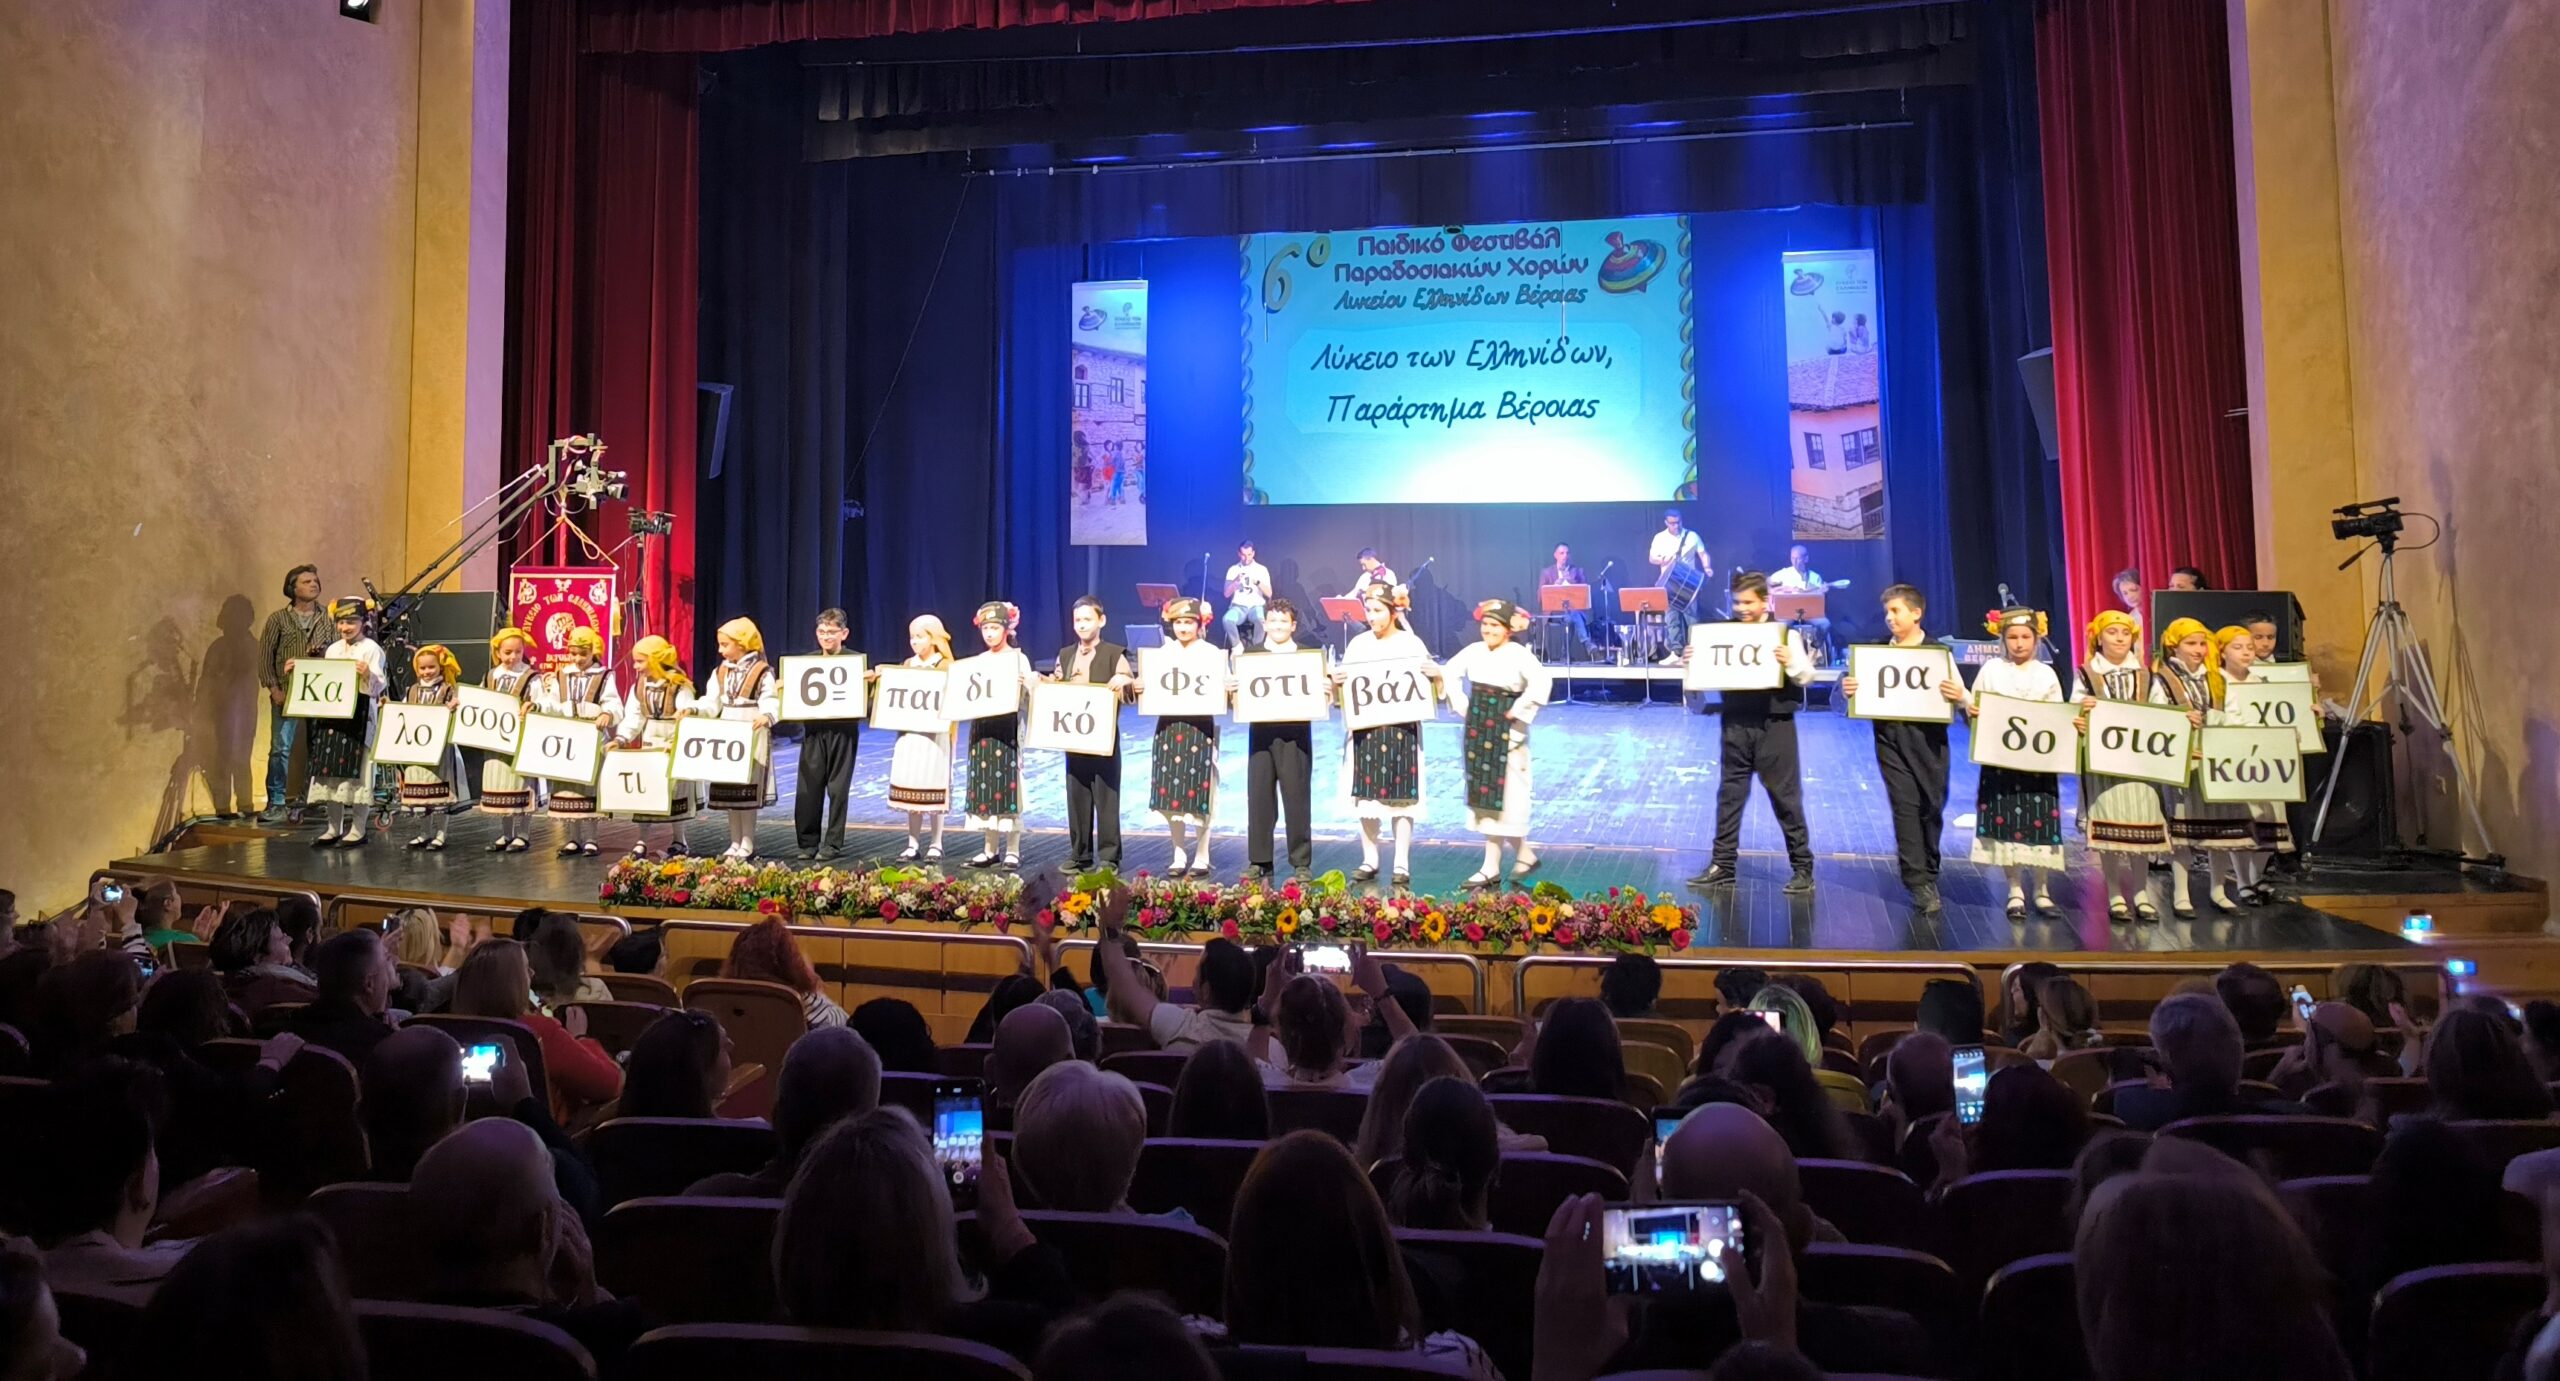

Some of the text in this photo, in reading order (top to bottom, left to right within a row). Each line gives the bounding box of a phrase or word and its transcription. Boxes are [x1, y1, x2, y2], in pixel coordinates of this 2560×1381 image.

[1358, 226, 1561, 256] Παιδικό Φεστιβάλ
[1334, 253, 1589, 286] Παραδοσιακών Χορών
[1333, 289, 1407, 311] Λυκείου
[1310, 335, 1613, 371] Λύκειο των Ελληνίδων,
[1327, 390, 1600, 429] Παράρτημα Βέροιας
[1709, 643, 1762, 668] πα
[300, 672, 343, 703] Κα
[966, 672, 995, 702] δι
[1160, 667, 1210, 696] Φε
[1250, 674, 1312, 698] στι
[1351, 670, 1427, 716] βάλ
[1877, 664, 1932, 699] ρα
[887, 687, 941, 712] παι
[2250, 700, 2296, 727] χο
[394, 711, 433, 747] λο
[460, 704, 517, 743] σορ
[1052, 708, 1096, 737] κό
[2001, 715, 2057, 756] δο
[541, 735, 577, 761] σι
[683, 737, 746, 763] στο
[2101, 724, 2177, 758] σια
[2207, 744, 2297, 784] κών
[617, 771, 648, 794] τι
